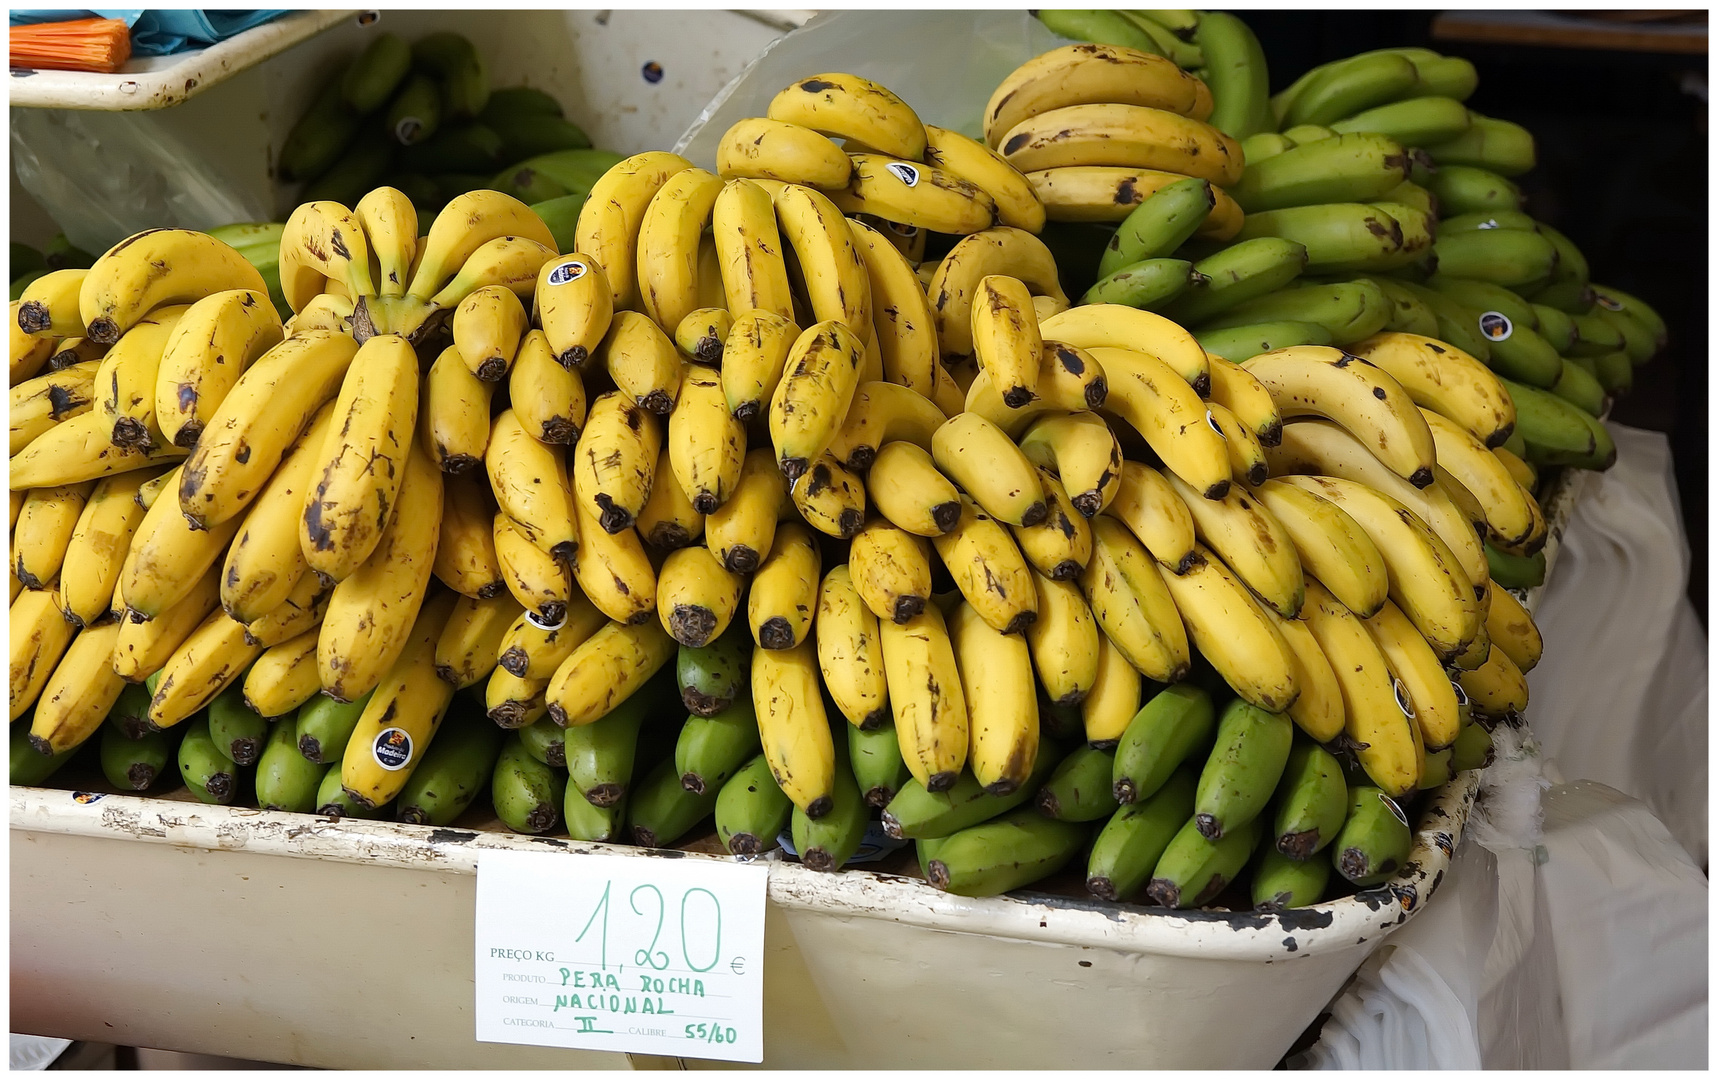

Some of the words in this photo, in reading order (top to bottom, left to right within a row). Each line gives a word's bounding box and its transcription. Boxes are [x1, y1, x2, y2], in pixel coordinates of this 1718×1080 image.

[377, 745, 406, 760] Madeira
[490, 948, 533, 962] PREÇO
[536, 951, 555, 962] KG
[575, 880, 721, 973] 1,20
[730, 956, 746, 975] €
[503, 973, 546, 984] PRODUTO
[559, 967, 621, 991] PERA
[640, 975, 705, 998] ROCHA
[503, 995, 539, 1006] ORIGEM
[553, 993, 674, 1014] NACIONAL
[503, 1017, 555, 1029] CATEGORIA
[628, 1026, 667, 1038] CALIBRE
[685, 1022, 737, 1044] 55/60
